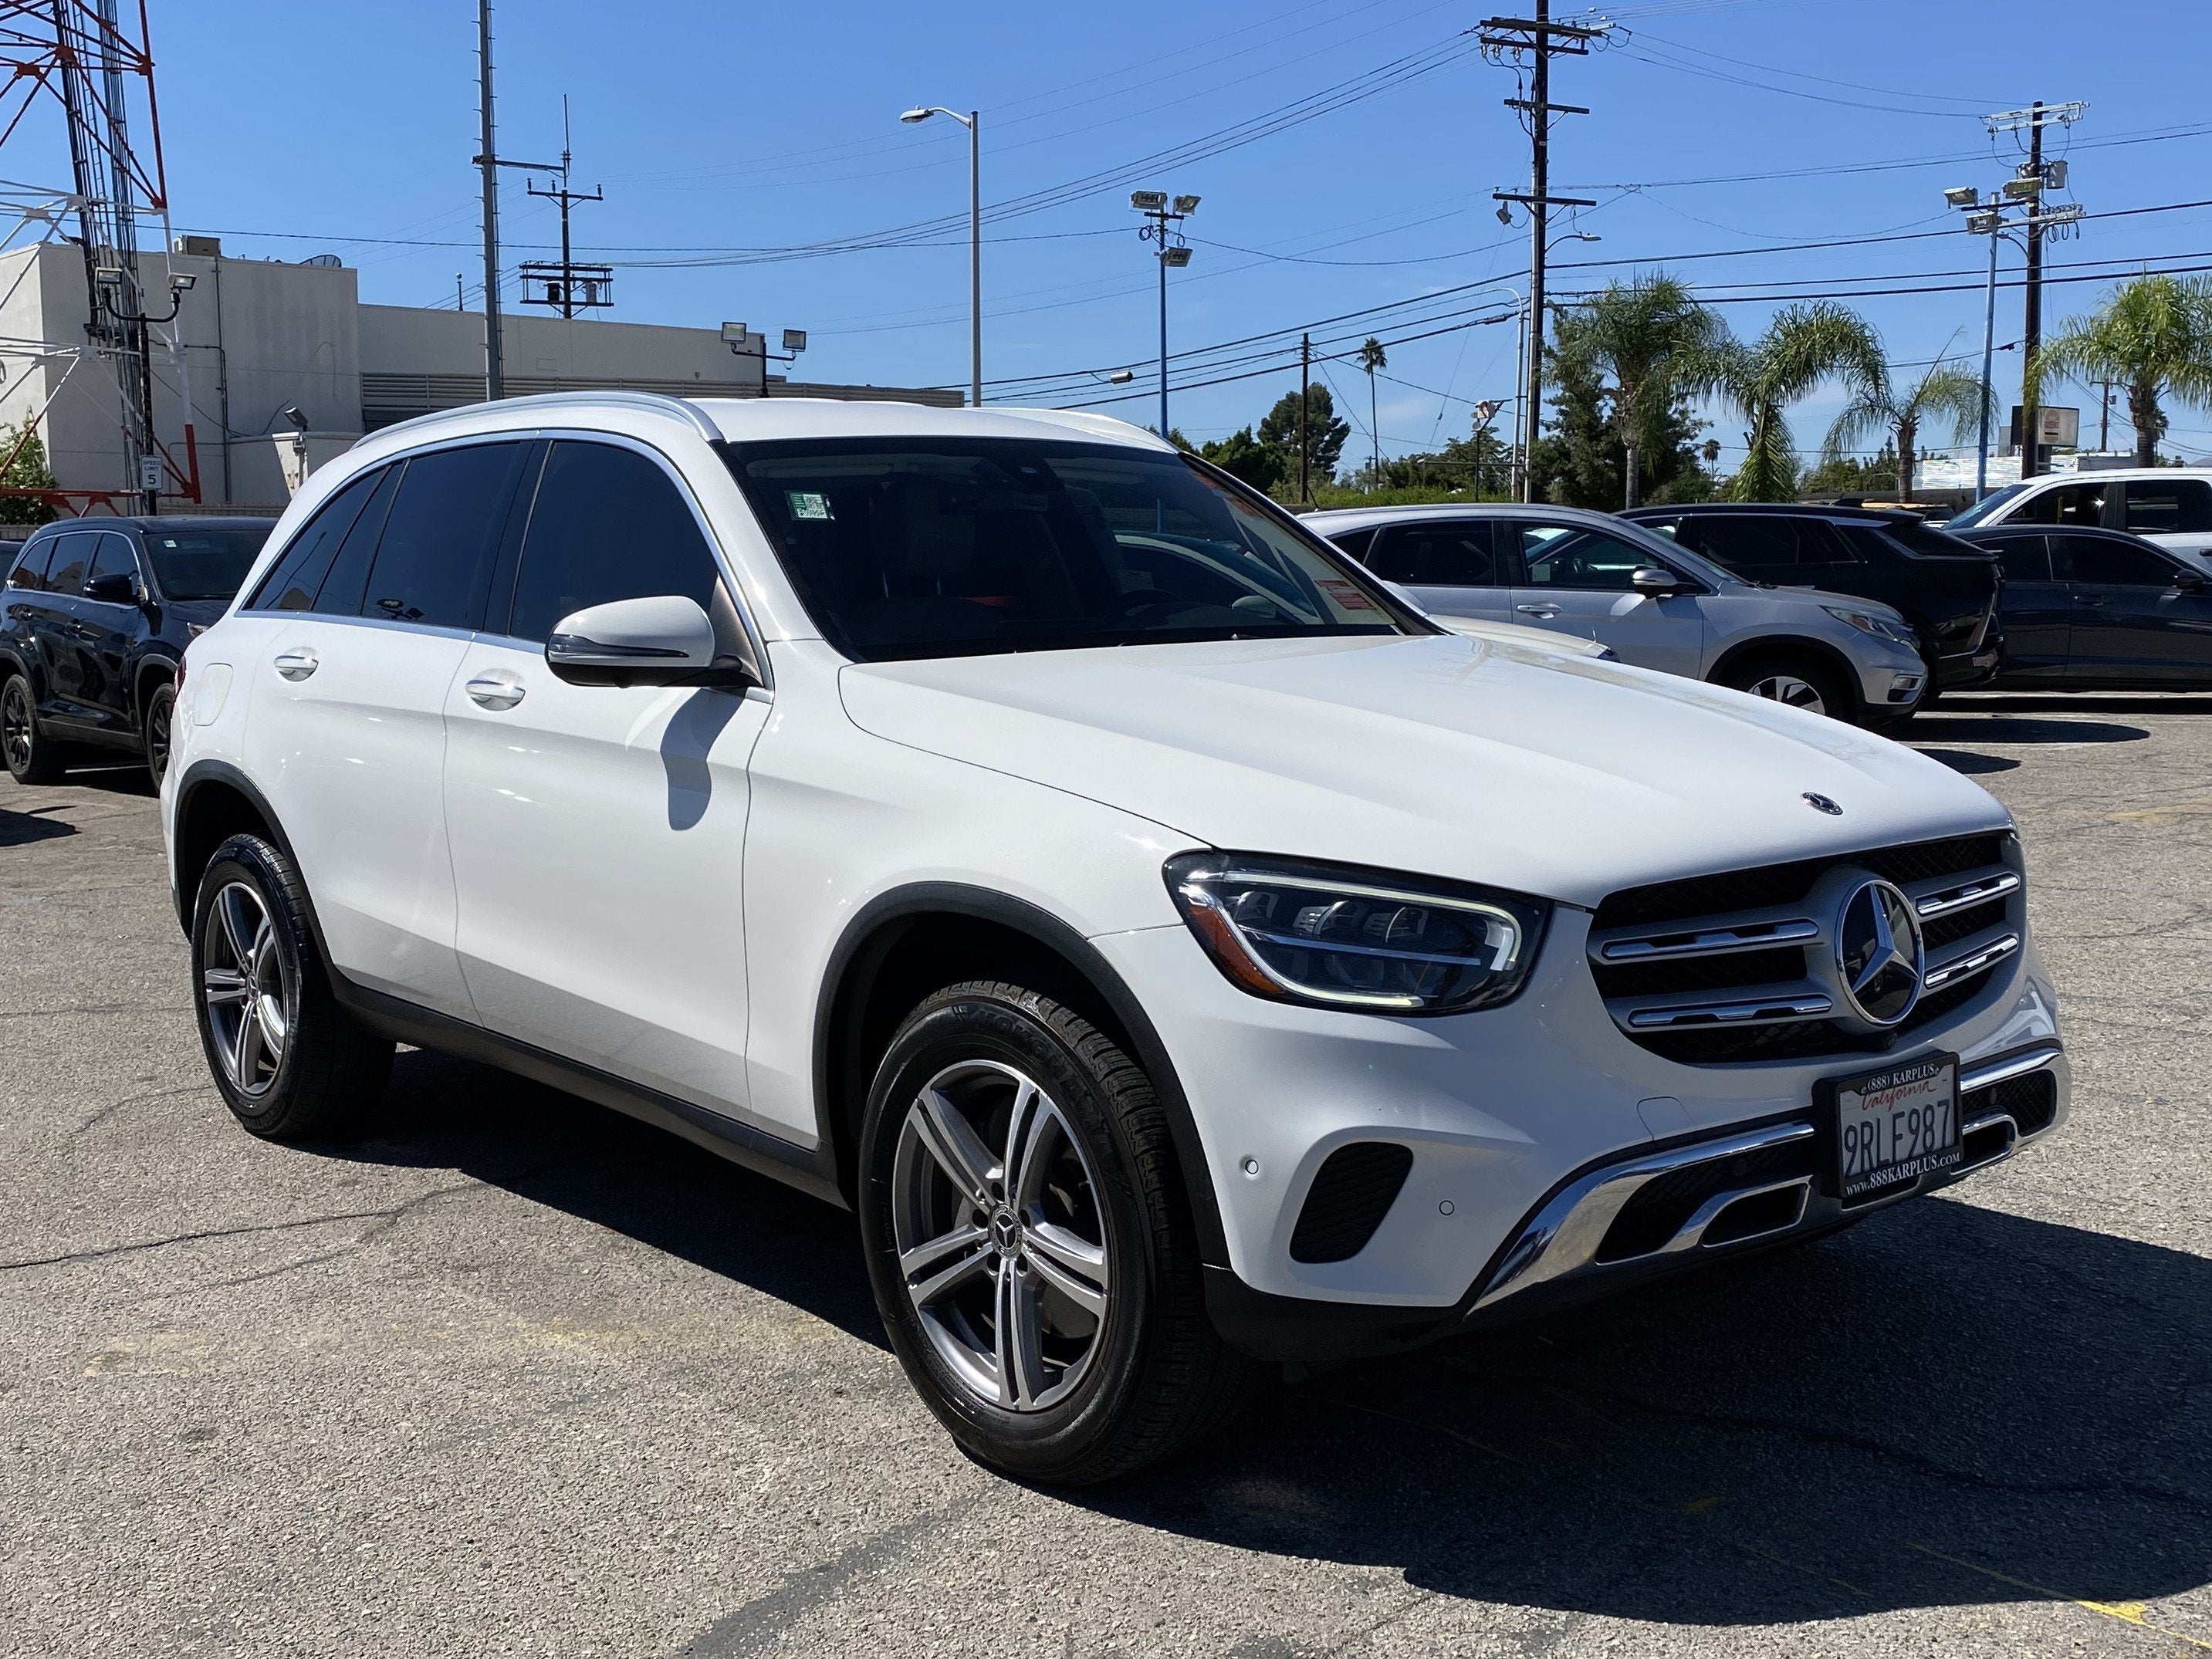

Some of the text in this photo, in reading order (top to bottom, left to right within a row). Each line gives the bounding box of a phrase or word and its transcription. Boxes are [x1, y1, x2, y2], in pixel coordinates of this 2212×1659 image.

[148, 475, 156, 485] 5
[1868, 1063, 1936, 1092] (888) KARPLUS
[1862, 1080, 1936, 1112] California
[1844, 1099, 1950, 1179] 9RLF987
